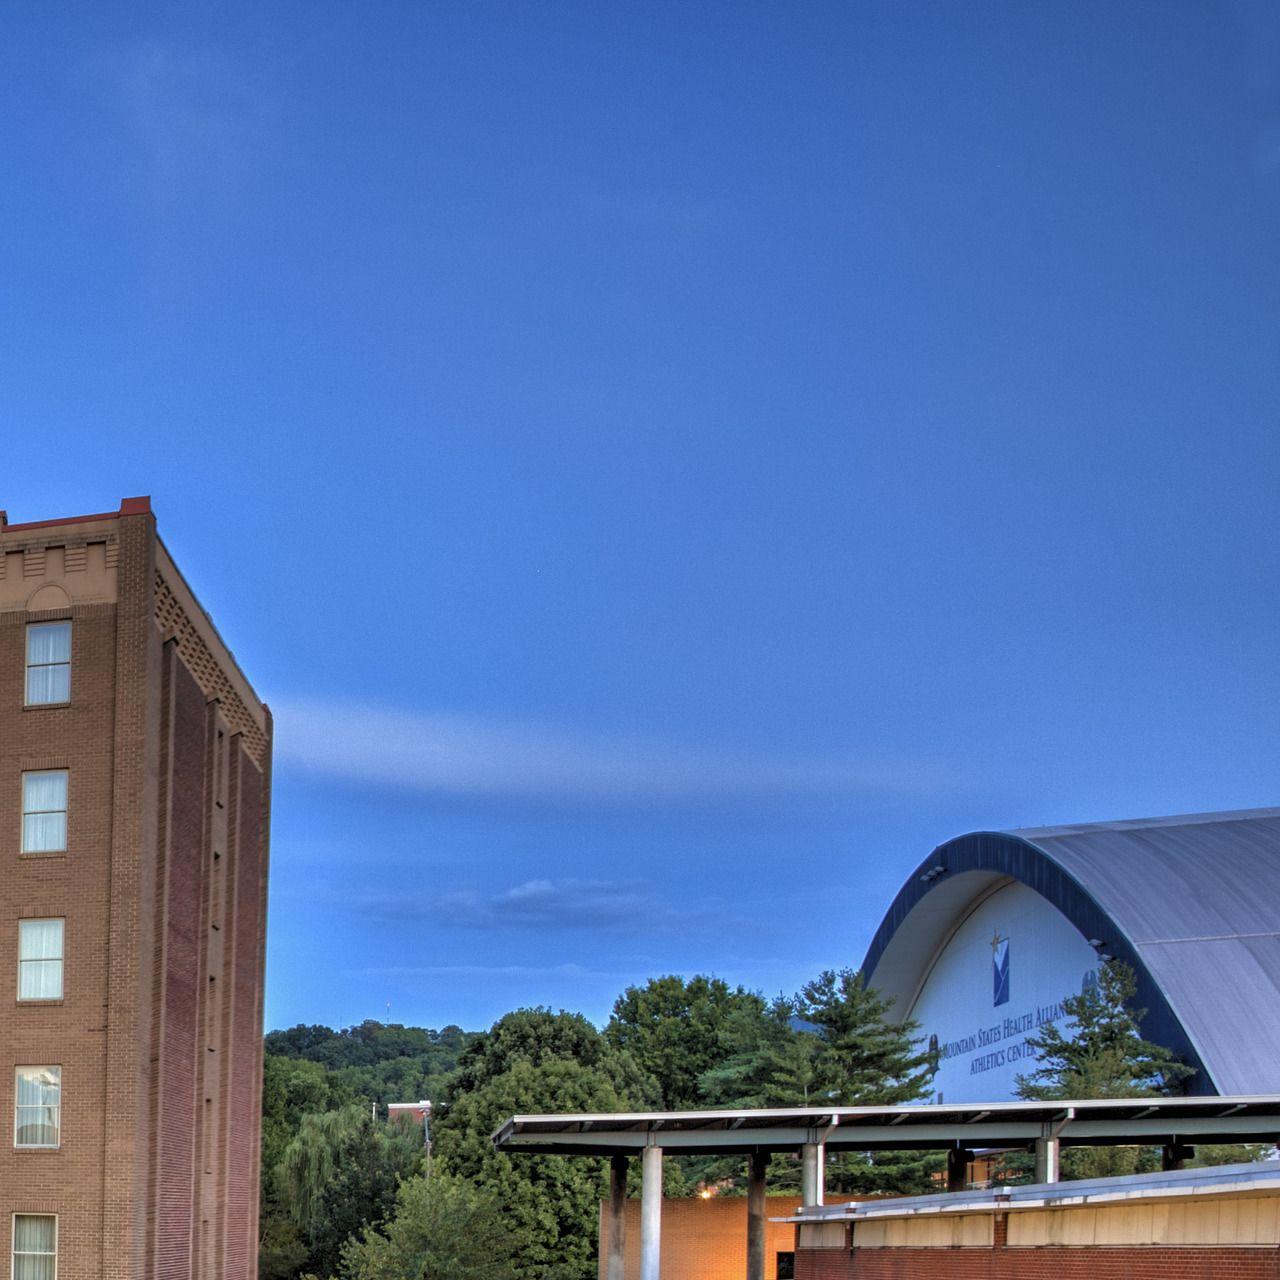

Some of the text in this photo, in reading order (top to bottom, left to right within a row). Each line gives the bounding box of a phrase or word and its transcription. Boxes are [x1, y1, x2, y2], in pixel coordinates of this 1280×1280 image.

[942, 1002, 1066, 1059] MOUNTAIN STATES HEALTH ALLIAN
[970, 1041, 1037, 1075] ATHLETICS CENTER
